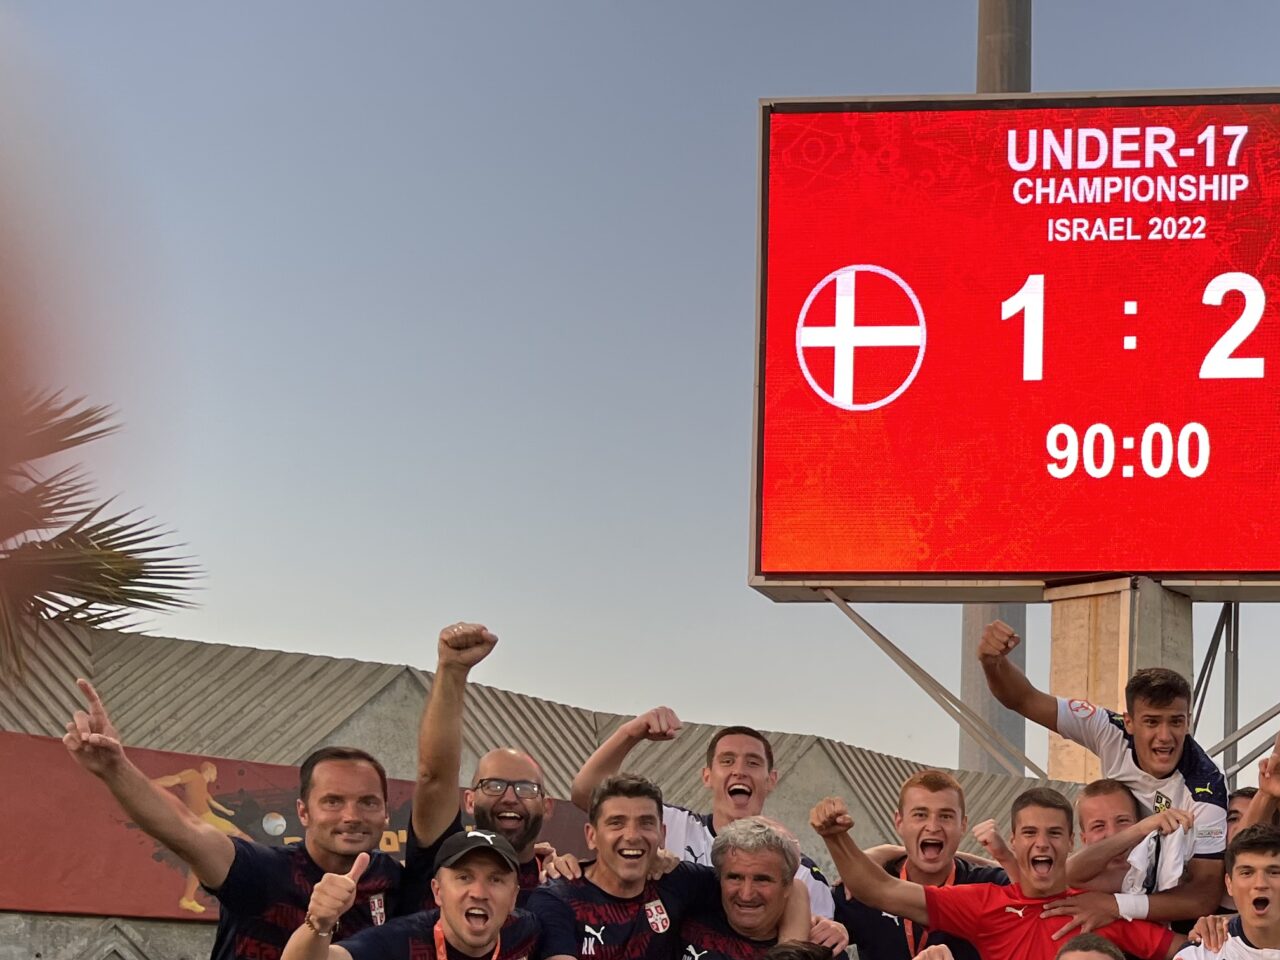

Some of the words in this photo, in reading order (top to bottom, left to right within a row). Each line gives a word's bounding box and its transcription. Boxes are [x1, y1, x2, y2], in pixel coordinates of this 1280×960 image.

[1007, 125, 1249, 171] UNDER-17
[1012, 174, 1249, 204] CHAMPIONSHIP
[1047, 218, 1141, 242] ISRAEL
[1148, 215, 1206, 240] 2022
[1001, 274, 1045, 381] 1
[1199, 271, 1266, 379] 2
[1046, 422, 1210, 479] 90:00
